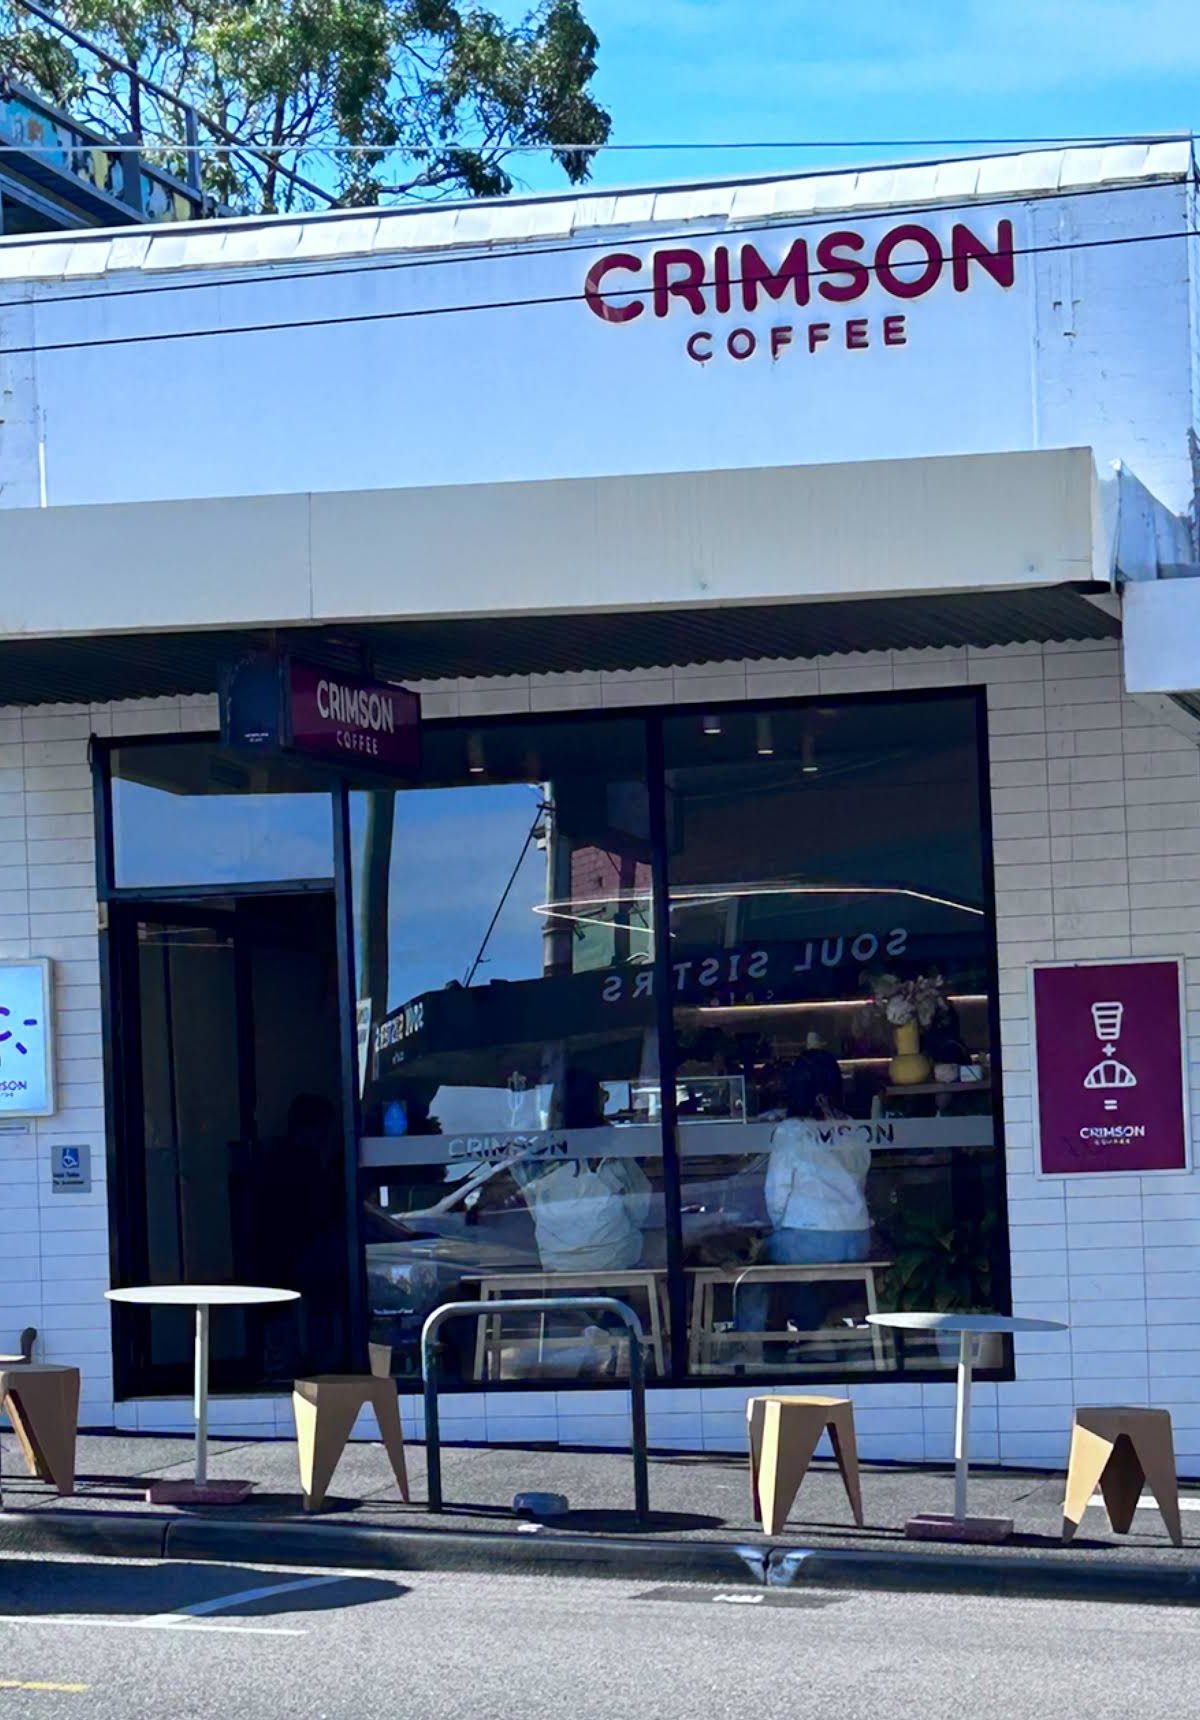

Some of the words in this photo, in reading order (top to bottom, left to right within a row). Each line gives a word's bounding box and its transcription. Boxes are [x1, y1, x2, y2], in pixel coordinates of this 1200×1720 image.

[584, 218, 1014, 324] CRIMSON
[687, 315, 907, 361] COFFEE
[316, 679, 395, 735] CRIMSON
[336, 729, 379, 756] COFFEE
[0, 1080, 27, 1091] SON
[1079, 1125, 1146, 1139] CRIMSON
